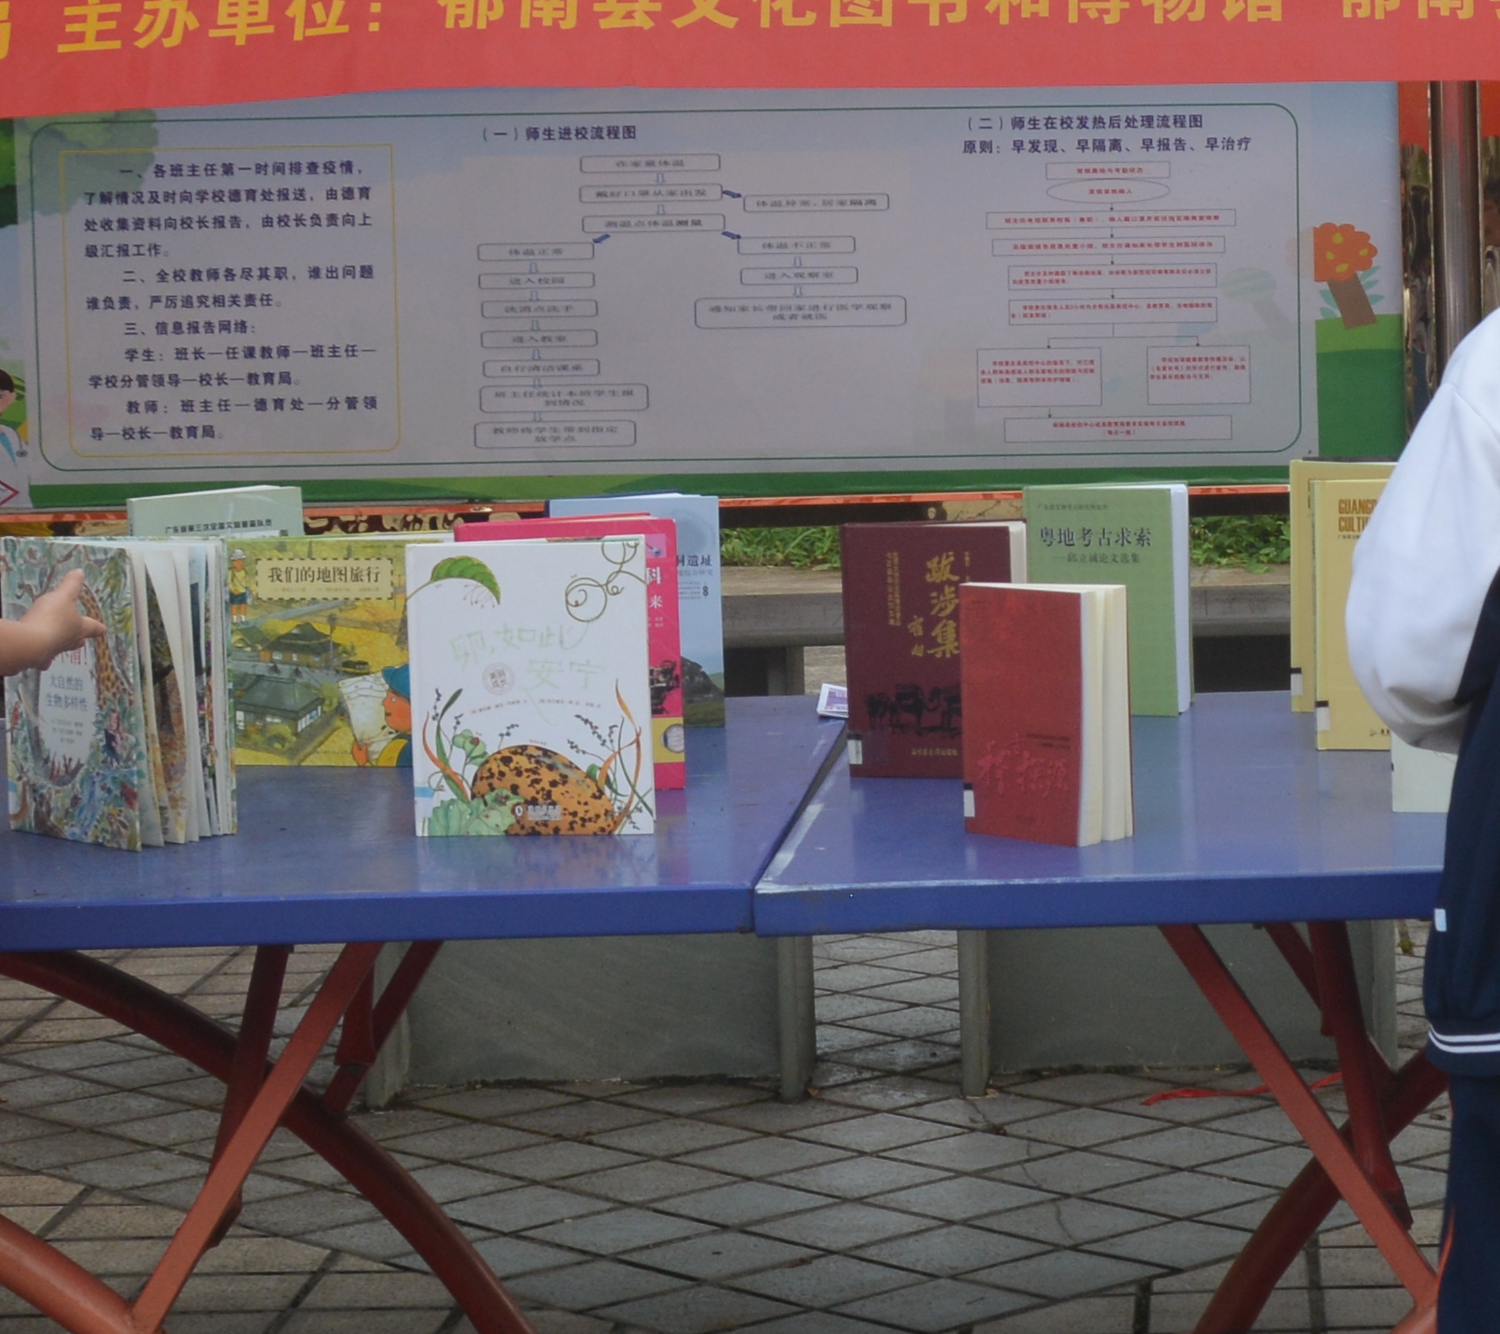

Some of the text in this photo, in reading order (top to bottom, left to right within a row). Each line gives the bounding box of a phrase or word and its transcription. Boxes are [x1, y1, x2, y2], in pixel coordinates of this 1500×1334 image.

[1040, 525, 1153, 548] 粤地考古求索
[267, 565, 382, 584] 我们的地图旅行
[47, 672, 84, 692] 大自然的
